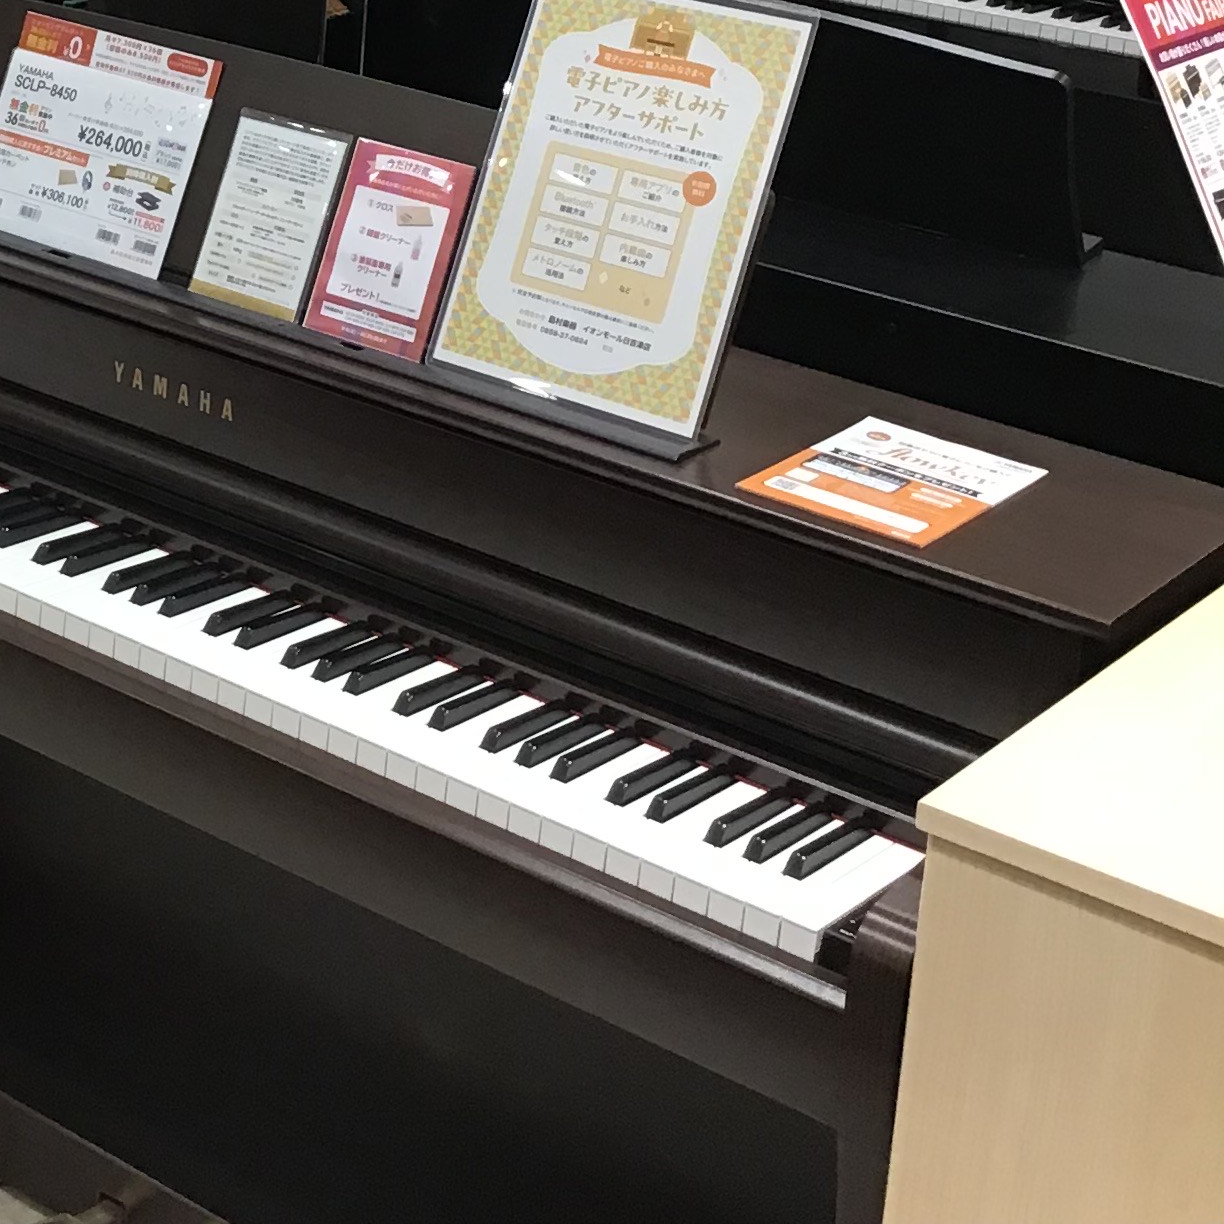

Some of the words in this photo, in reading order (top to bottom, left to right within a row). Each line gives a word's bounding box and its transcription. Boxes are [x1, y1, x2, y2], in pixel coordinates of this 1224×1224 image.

[18, 63, 55, 81] YAMAHA
[14, 74, 78, 102] SCLP-8450
[566, 65, 730, 122] 電子ピアノ楽しみ方
[573, 95, 705, 141] アフターサポート
[77, 124, 143, 158] ¥264,000
[356, 264, 388, 279] クリーナー
[531, 253, 584, 276] メトロノームの
[340, 282, 381, 305] プレゼント!
[619, 284, 632, 295] など
[112, 360, 236, 423] YAMAHA
